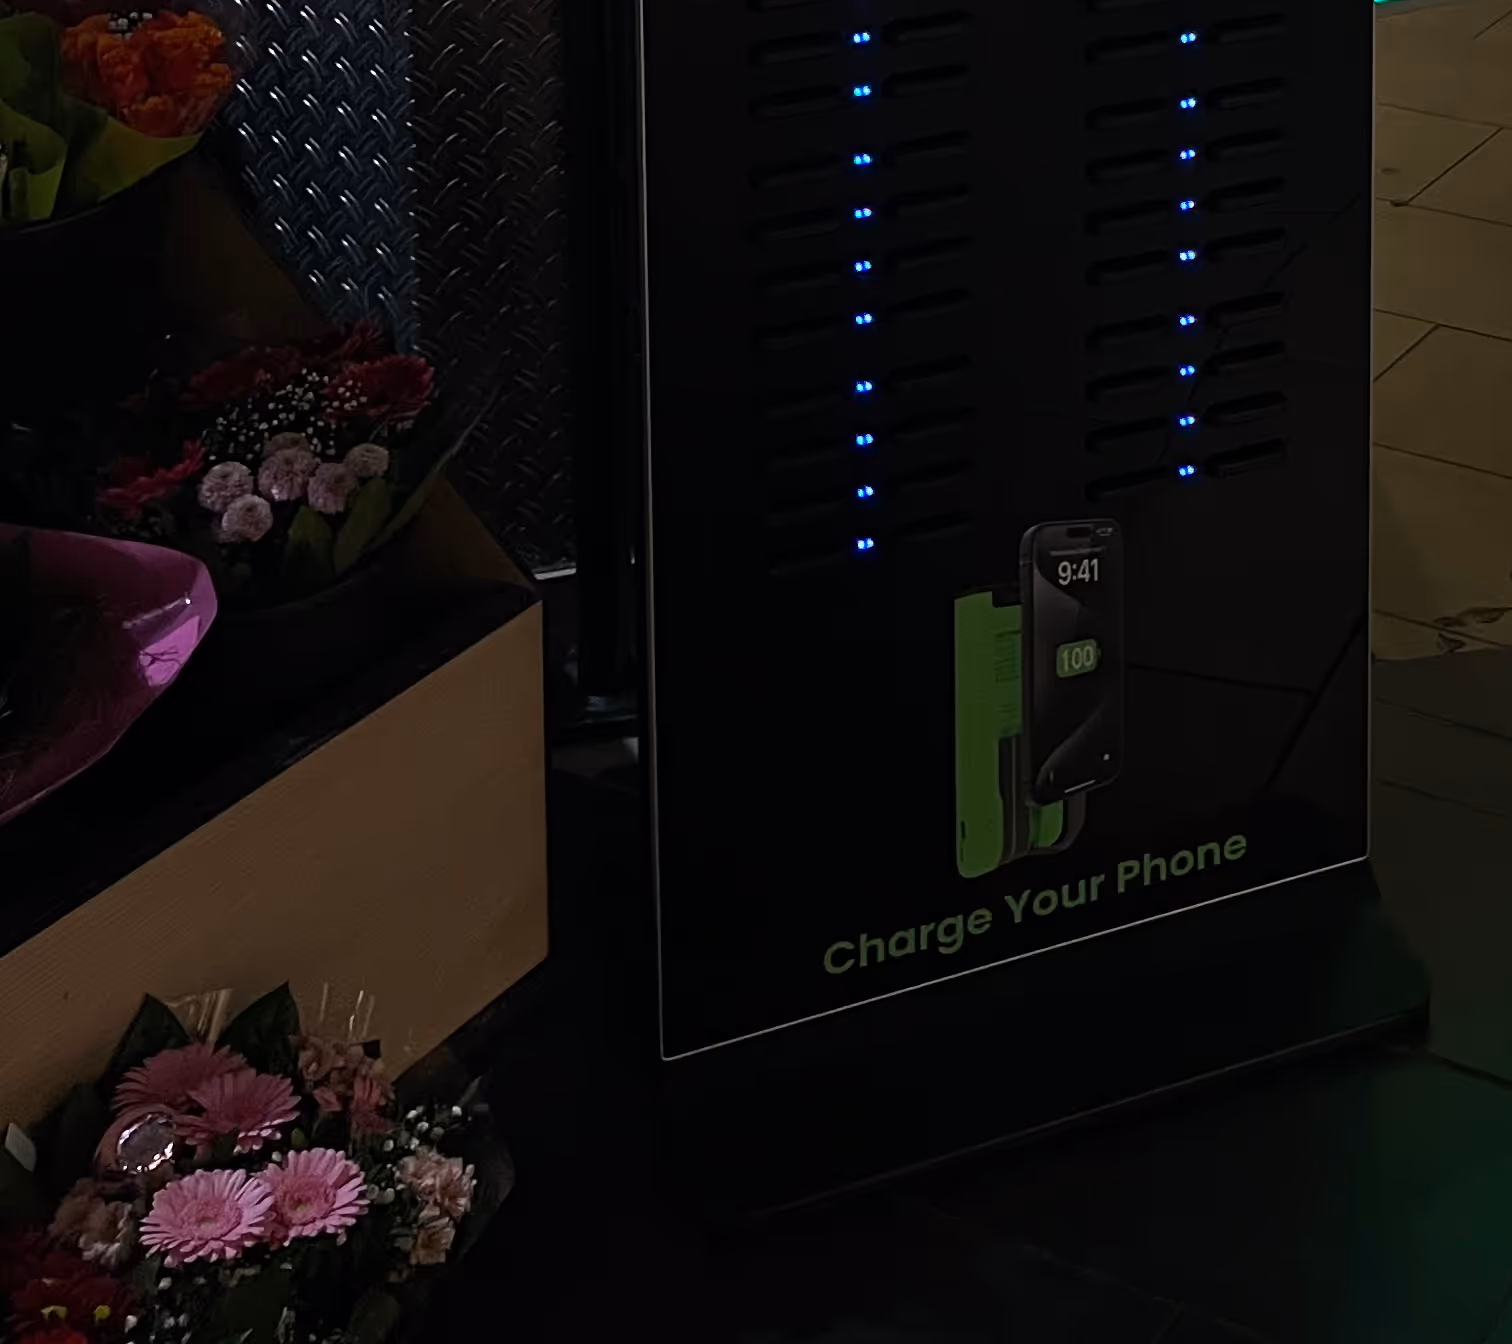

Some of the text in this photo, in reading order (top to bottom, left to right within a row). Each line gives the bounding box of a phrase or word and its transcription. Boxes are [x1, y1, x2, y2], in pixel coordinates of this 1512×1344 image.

[1057, 558, 1100, 587] 9:41
[1061, 644, 1096, 674] 100
[823, 833, 1248, 975] Charge Your Phone
